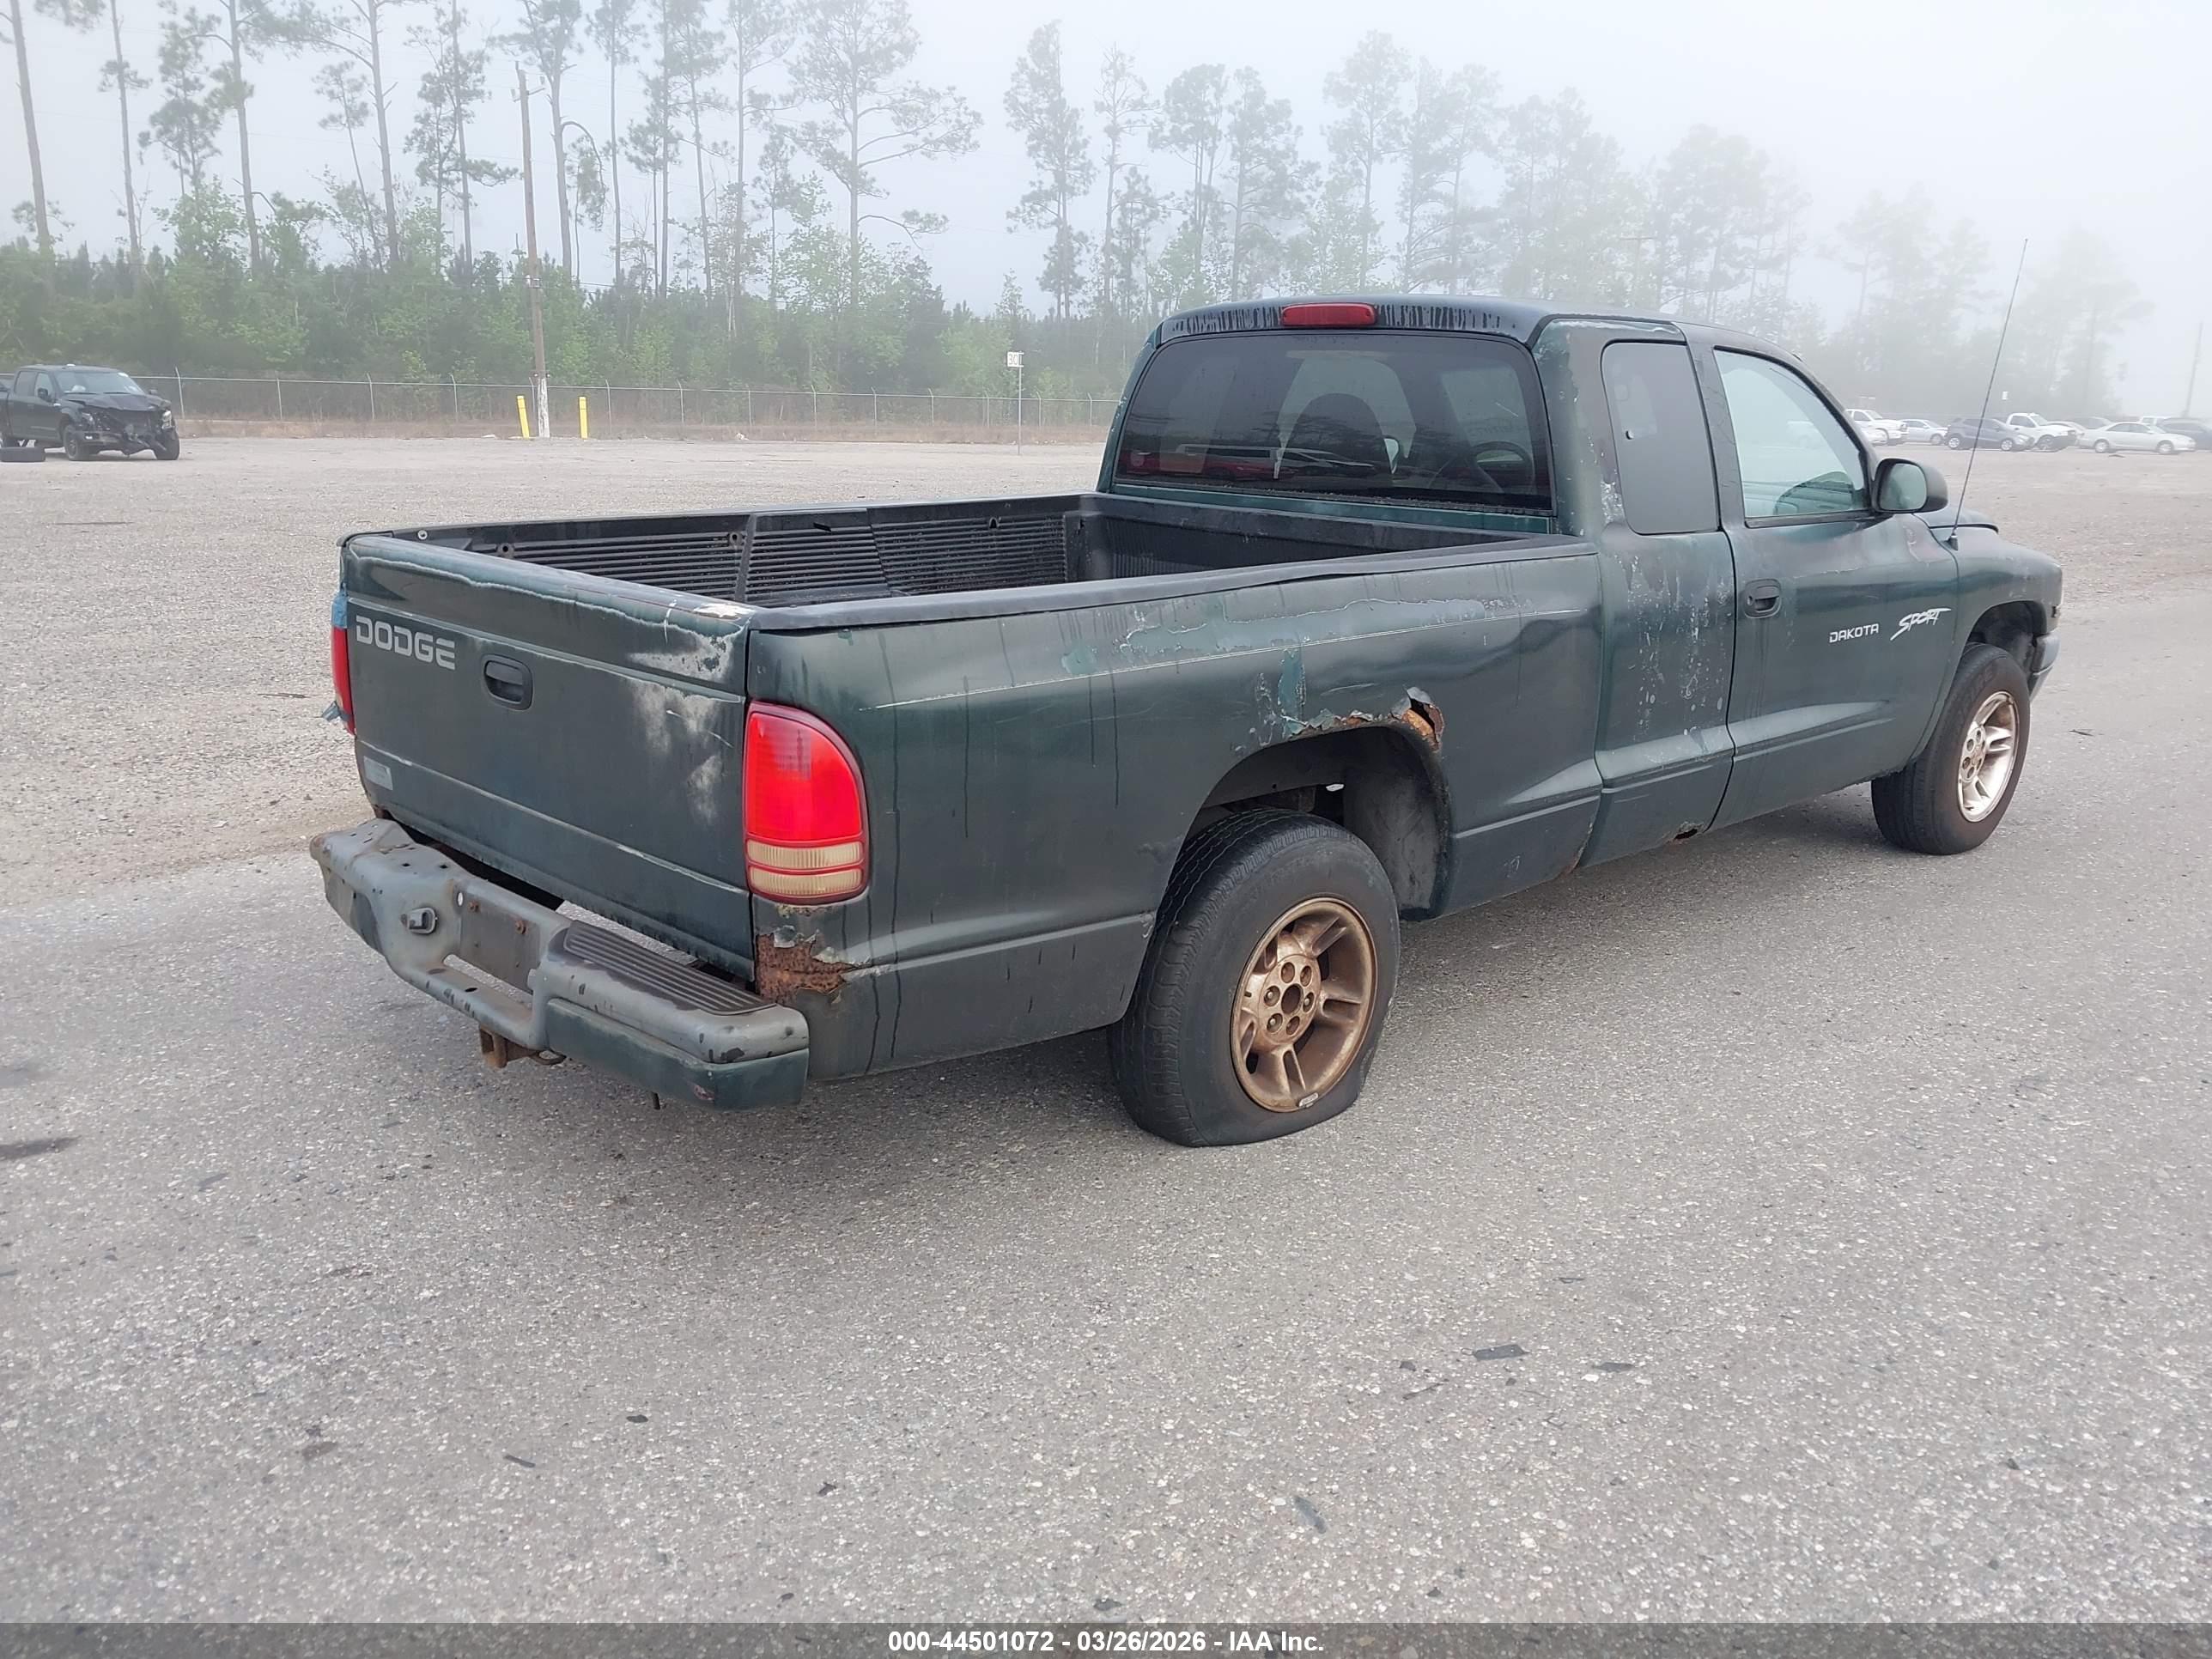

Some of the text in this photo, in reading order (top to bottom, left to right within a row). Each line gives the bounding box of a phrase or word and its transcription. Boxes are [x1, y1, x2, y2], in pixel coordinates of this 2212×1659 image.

[356, 614, 456, 671] DODGE
[1829, 607, 1952, 643] DAKOTA SPORT
